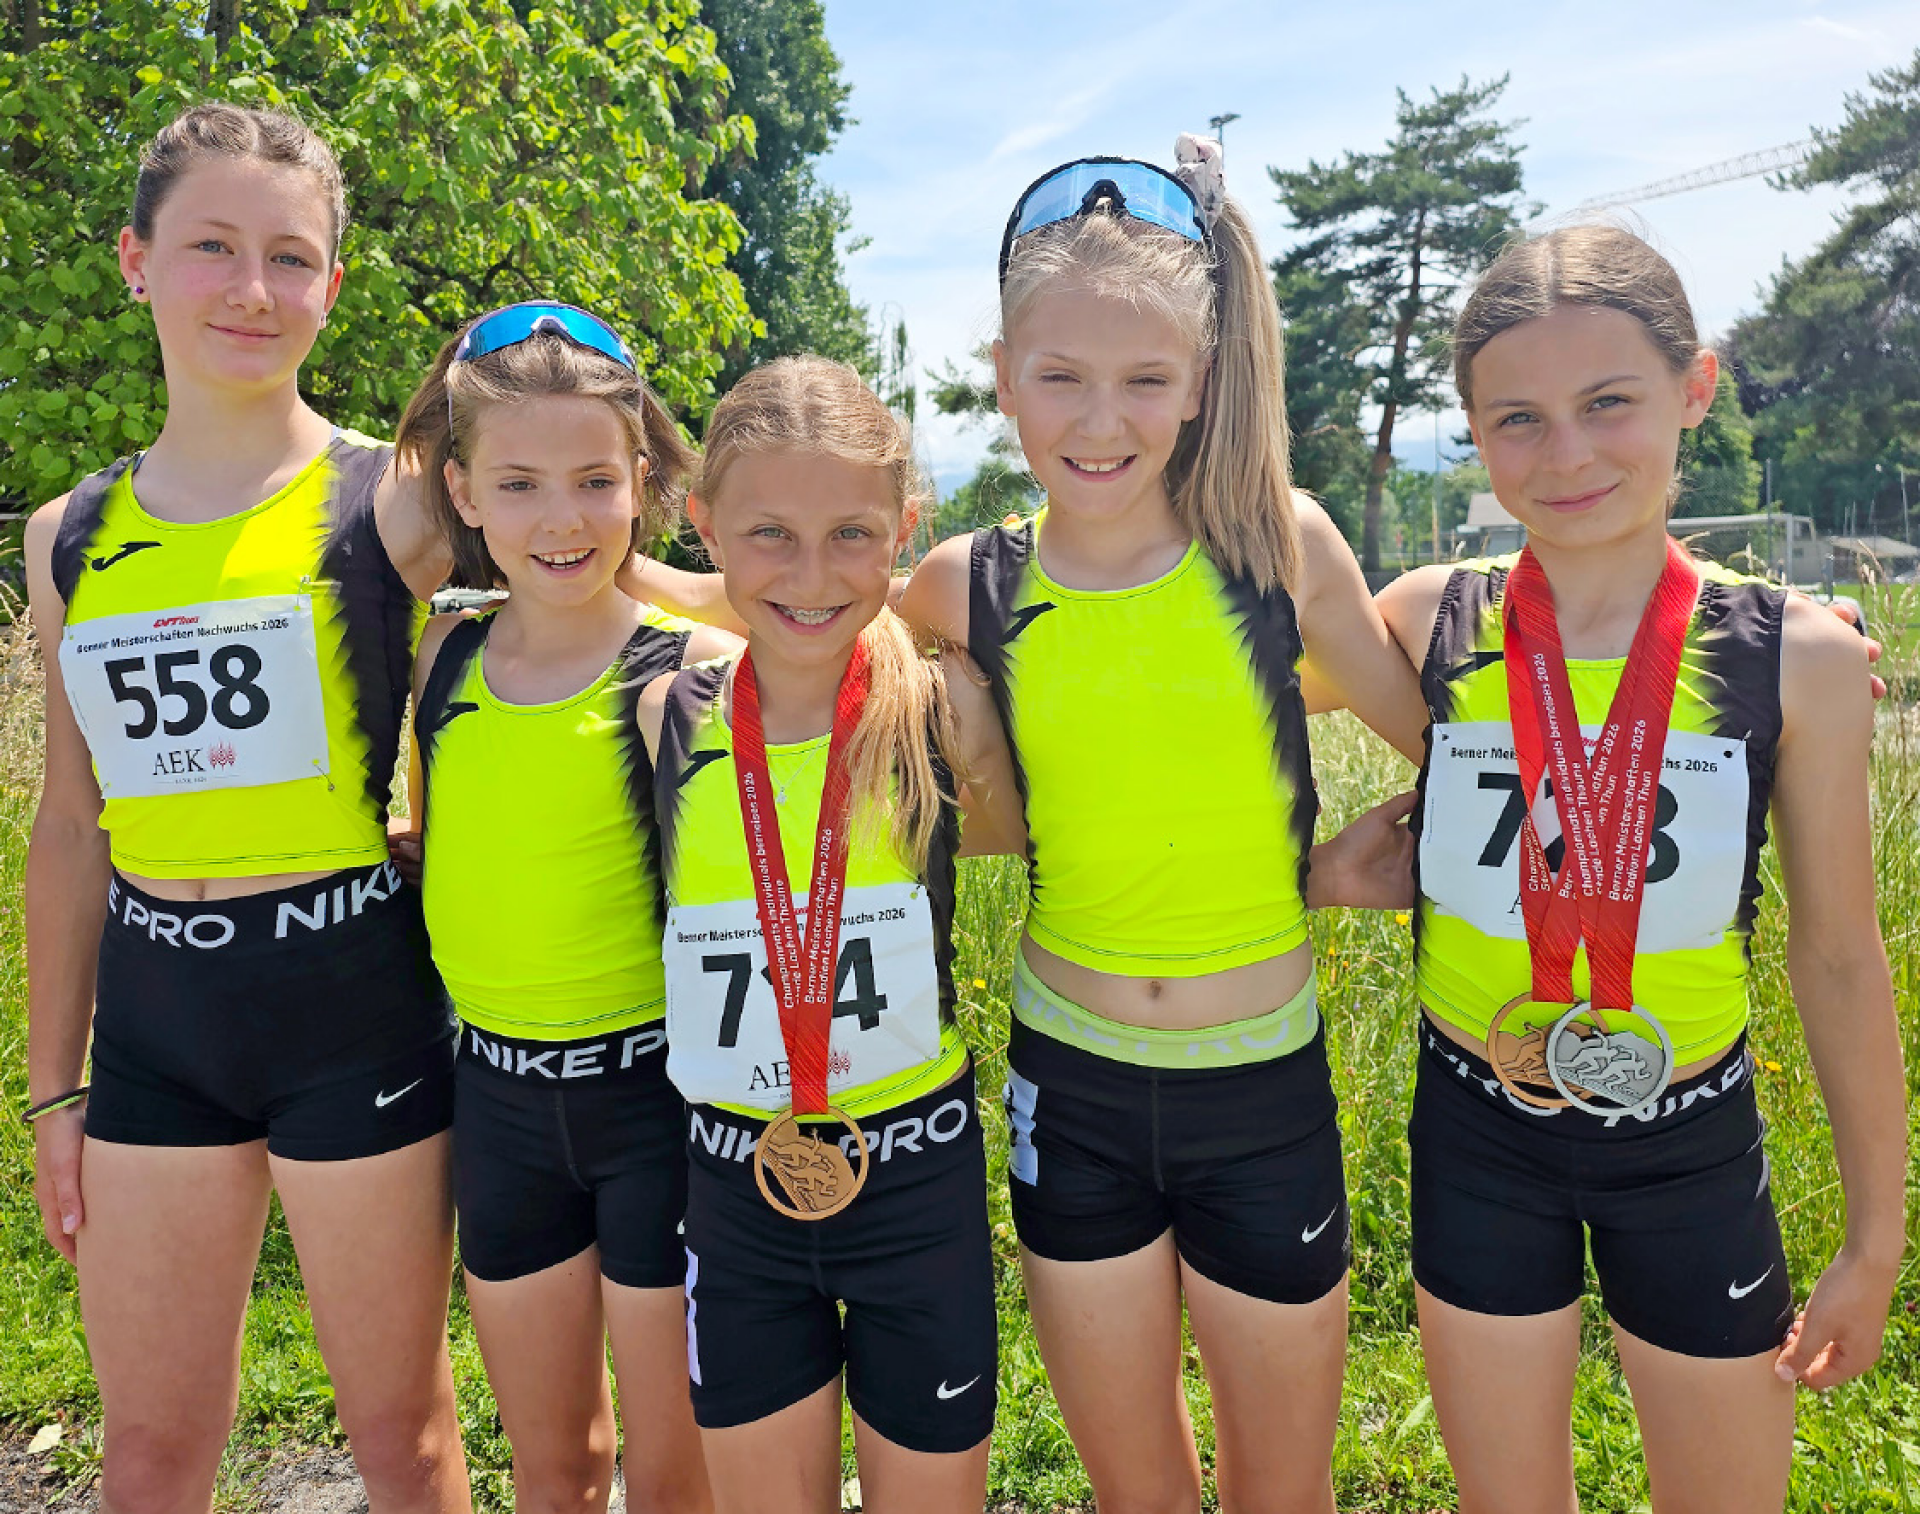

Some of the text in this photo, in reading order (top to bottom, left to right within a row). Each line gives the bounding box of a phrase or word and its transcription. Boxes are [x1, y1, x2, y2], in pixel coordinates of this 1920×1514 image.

[110, 629, 194, 649] Meisterschaften
[197, 622, 258, 639] Nachwuchs
[260, 617, 289, 631] 2026
[1532, 652, 1549, 682] 2026
[104, 644, 270, 740] 558
[1601, 723, 1620, 755] 2026
[152, 747, 206, 776] AEK
[1451, 746, 1488, 759] Berner
[1684, 758, 1718, 773] 2026
[743, 771, 757, 800] 2026
[1599, 775, 1618, 805] Thun
[1608, 719, 1646, 902] Berner Meisterschaften 2026
[1567, 806, 1594, 897] Championnats
[1622, 770, 1652, 902] Stadion Lachen Thun
[123, 896, 236, 949] PRO
[275, 858, 402, 940] NIKE
[826, 877, 838, 907] Thun
[804, 827, 832, 1004] Berner Meisterschaften 2026
[878, 907, 906, 921] 2026
[771, 922, 794, 1009] Championnats
[470, 1028, 607, 1080] NIKE
